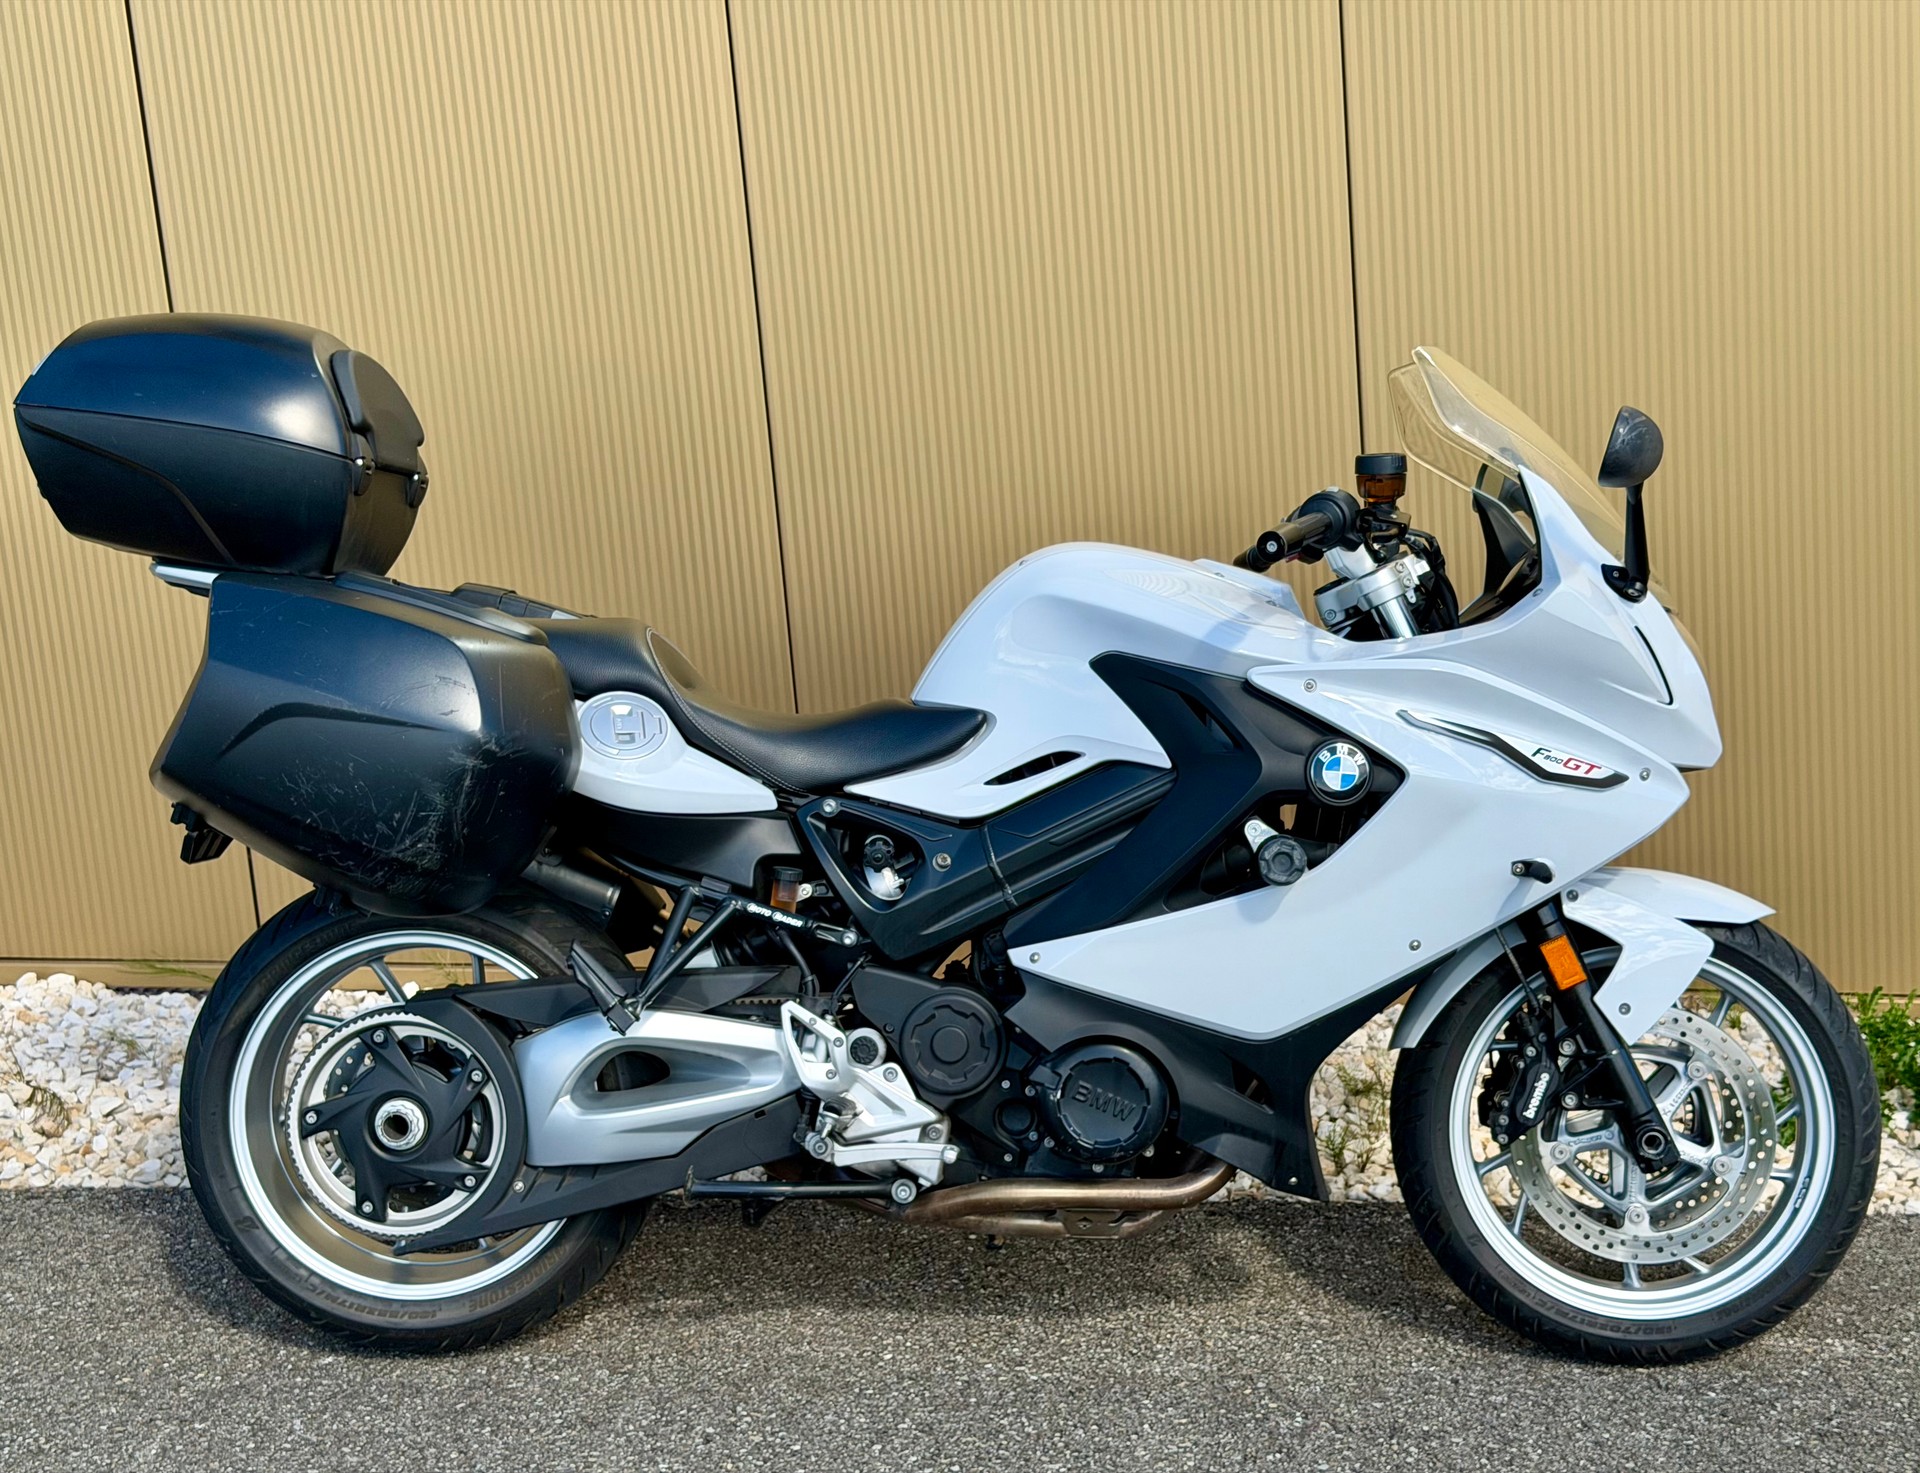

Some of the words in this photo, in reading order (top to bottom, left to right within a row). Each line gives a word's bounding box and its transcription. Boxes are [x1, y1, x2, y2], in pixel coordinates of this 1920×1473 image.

[1318, 743, 1366, 766] BMW
[1072, 1080, 1137, 1122] BMW
[1522, 1072, 1550, 1119] brembo
